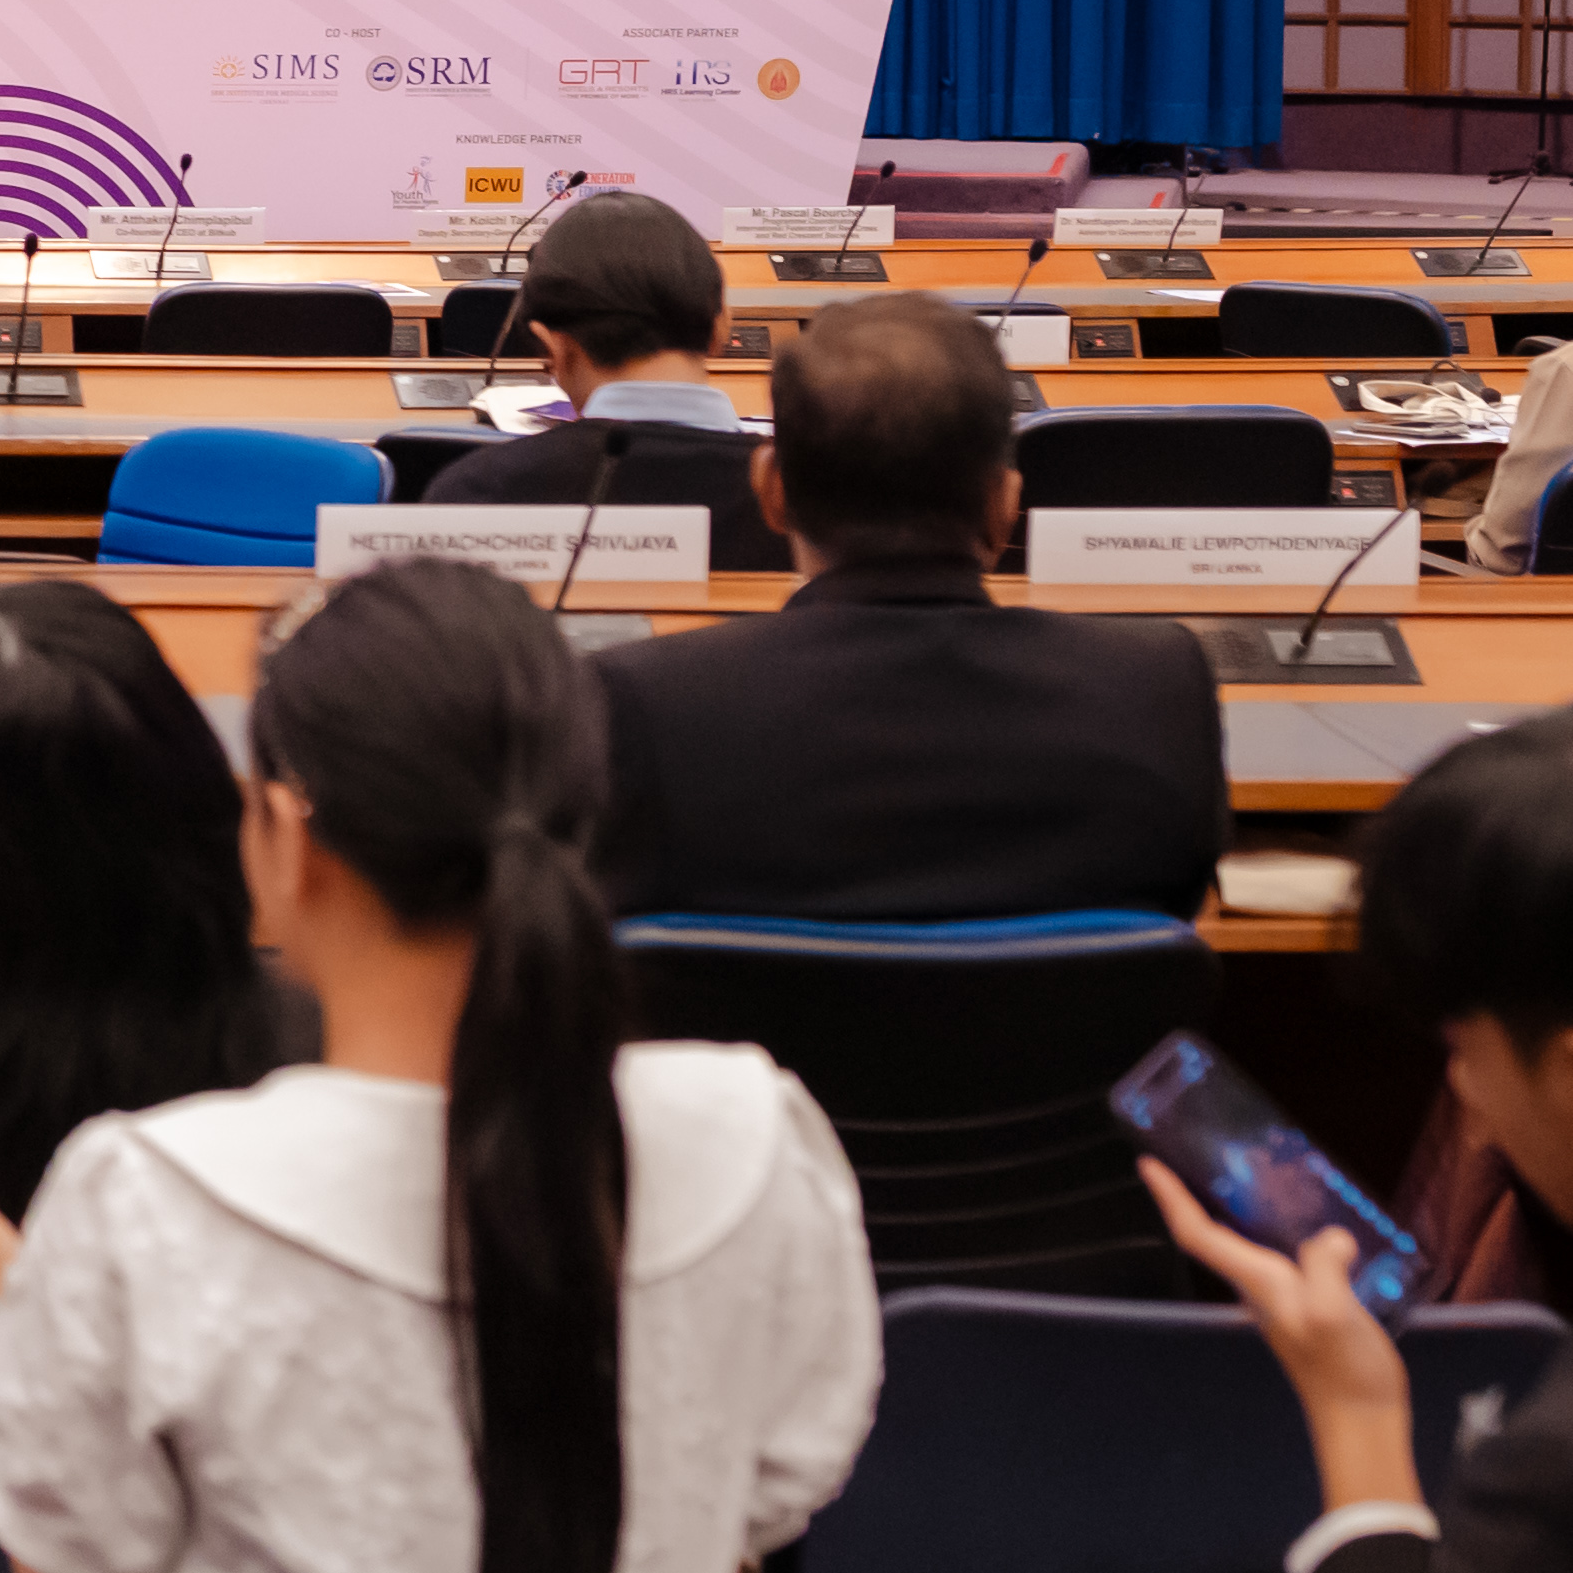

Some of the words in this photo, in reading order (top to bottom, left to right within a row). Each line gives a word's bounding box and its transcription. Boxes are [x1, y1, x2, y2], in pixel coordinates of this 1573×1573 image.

[351, 28, 381, 38] HOST
[622, 28, 684, 38] ASSOCIATE
[686, 28, 739, 38] PARTNER
[252, 54, 340, 80] SIMS
[406, 56, 492, 85] SRM
[559, 59, 650, 85] GRT
[455, 135, 527, 145] KNOWLEDGE
[530, 135, 582, 145] PARTNER
[586, 173, 635, 184] ENERATION
[468, 178, 521, 193] ICWU
[391, 190, 424, 200] Youth
[772, 208, 810, 217] Pascal
